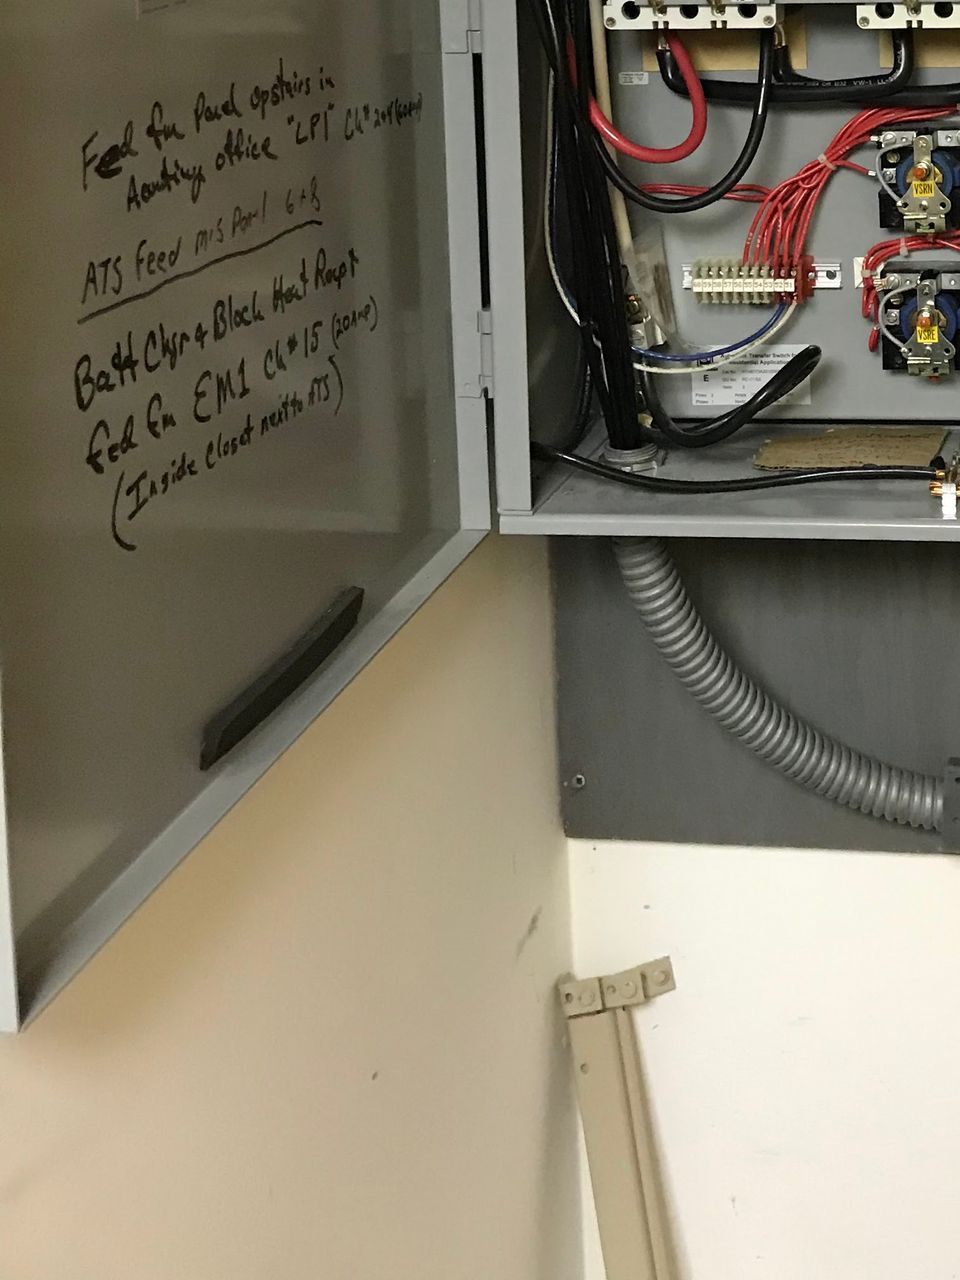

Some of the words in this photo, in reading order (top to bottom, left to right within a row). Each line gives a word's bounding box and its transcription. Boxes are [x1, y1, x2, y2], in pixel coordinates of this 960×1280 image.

[319, 66, 335, 92] in
[914, 182, 933, 196] VSRN
[81, 256, 122, 305] ATS
[136, 239, 182, 281] Feed
[917, 329, 936, 342] VSRE
[74, 354, 139, 412] Batt
[213, 291, 265, 342] Block
[703, 374, 709, 382] E
[112, 452, 198, 551] (Inside
[205, 414, 254, 469] Closet
